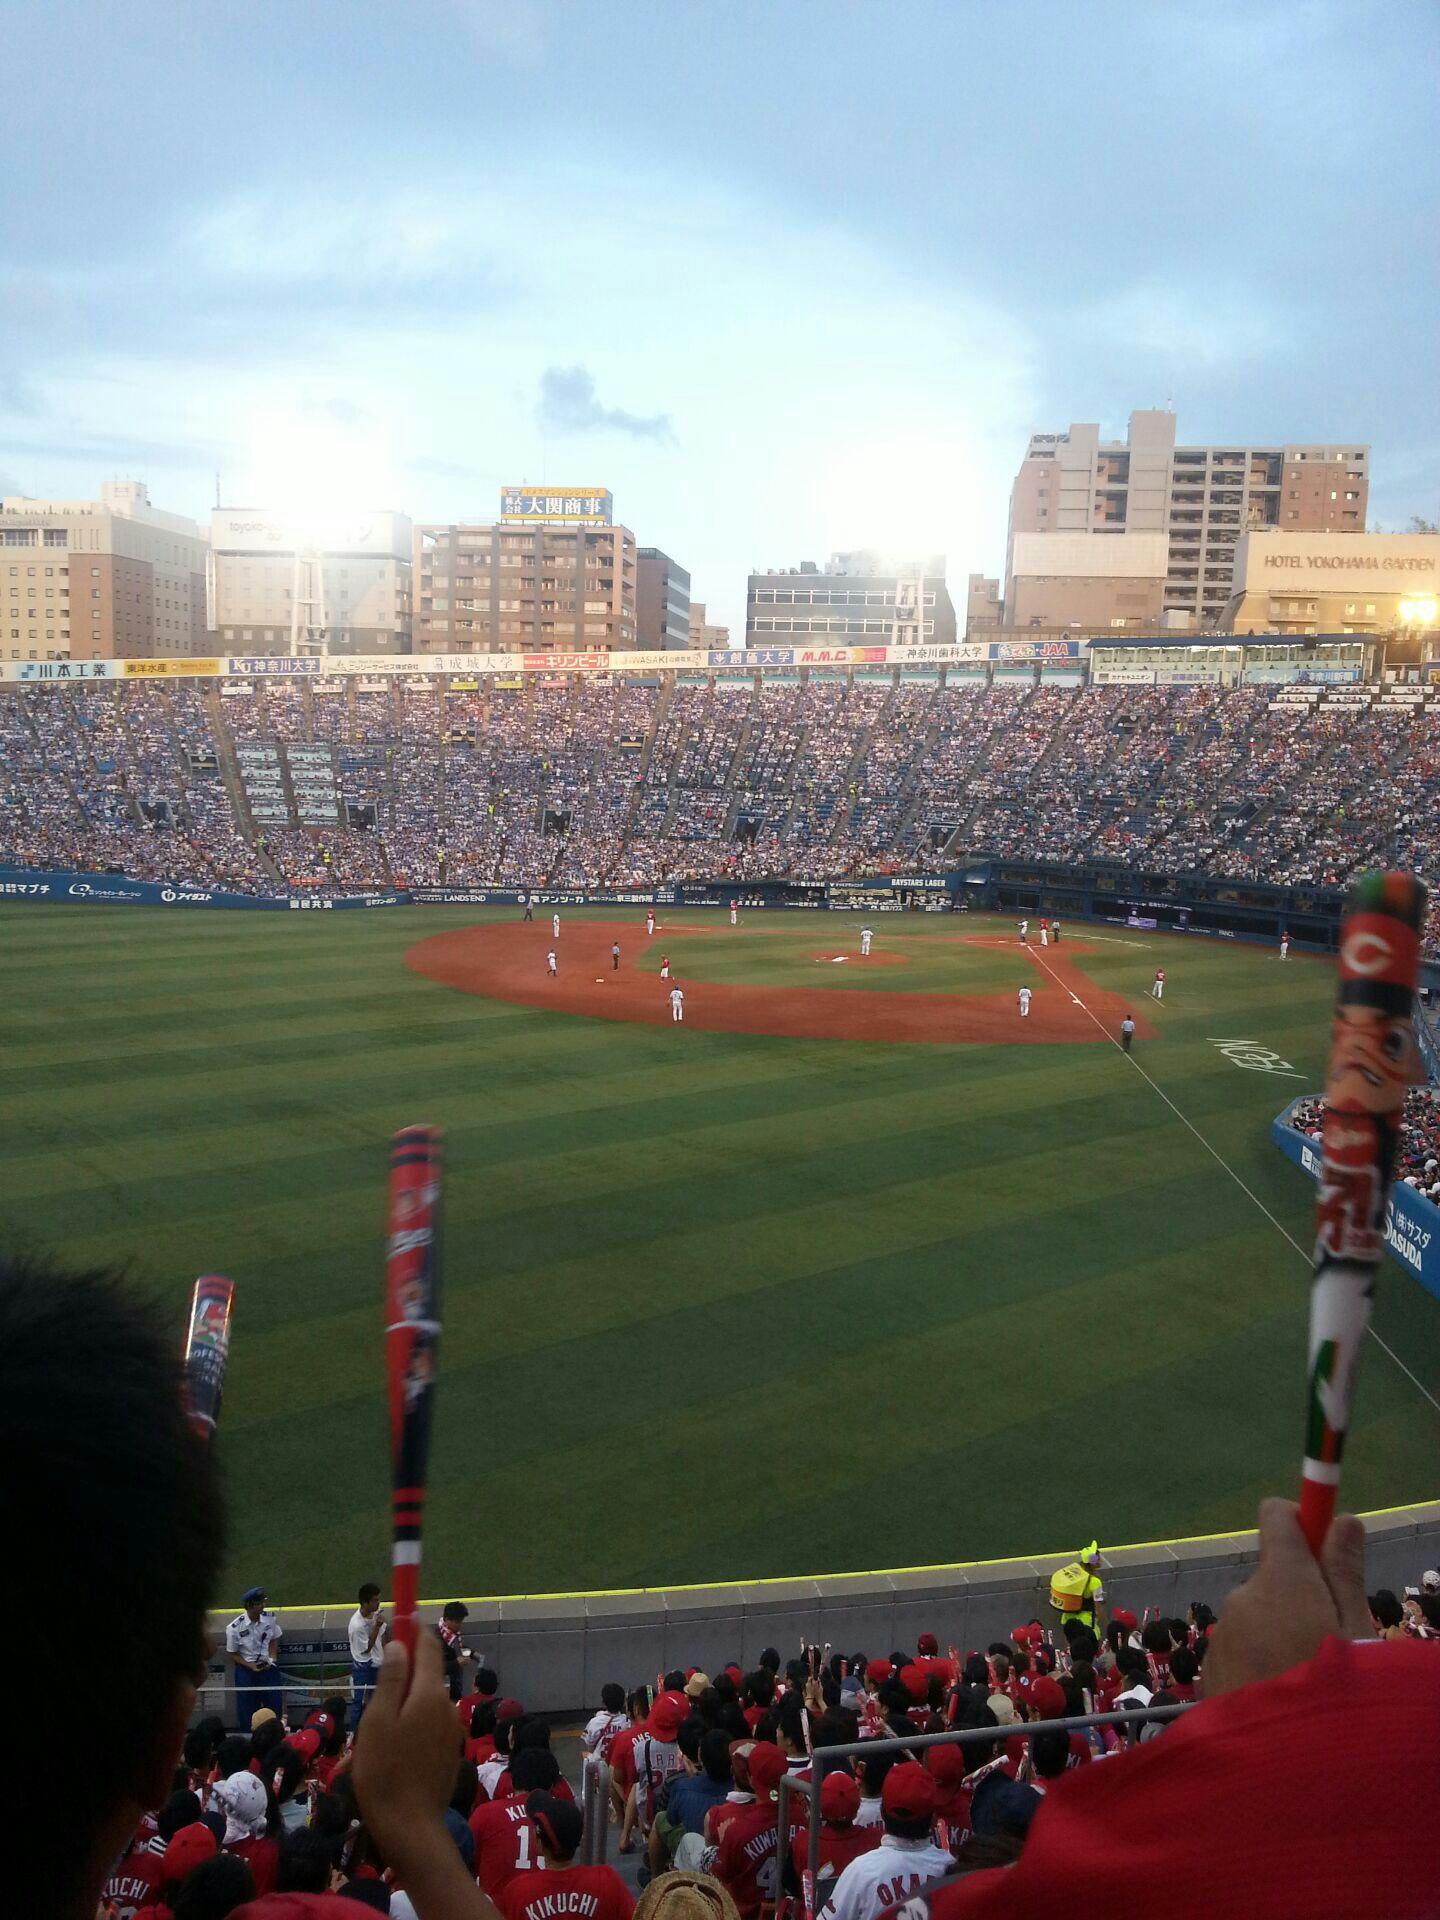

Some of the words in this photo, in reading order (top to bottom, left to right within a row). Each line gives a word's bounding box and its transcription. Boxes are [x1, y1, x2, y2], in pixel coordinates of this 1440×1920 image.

[526, 496, 601, 515] 大関商事
[1264, 555, 1304, 569] HOTEL
[1307, 556, 1379, 570] YOKOHAMA
[1382, 557, 1436, 571] GARDEN
[907, 646, 983, 659] 神奈川歯科大学
[1040, 643, 1069, 656] JAA
[450, 656, 513, 670] 成城大学
[546, 654, 609, 668] キリンビール
[730, 651, 790, 664] 創価大学
[39, 663, 107, 678] 川本工業
[127, 663, 167, 673] 東洋水産
[254, 659, 316, 672] 神奈川大学
[891, 879, 924, 887] BAYSTARS
[525, 1892, 600, 1920] KIKUCHI
